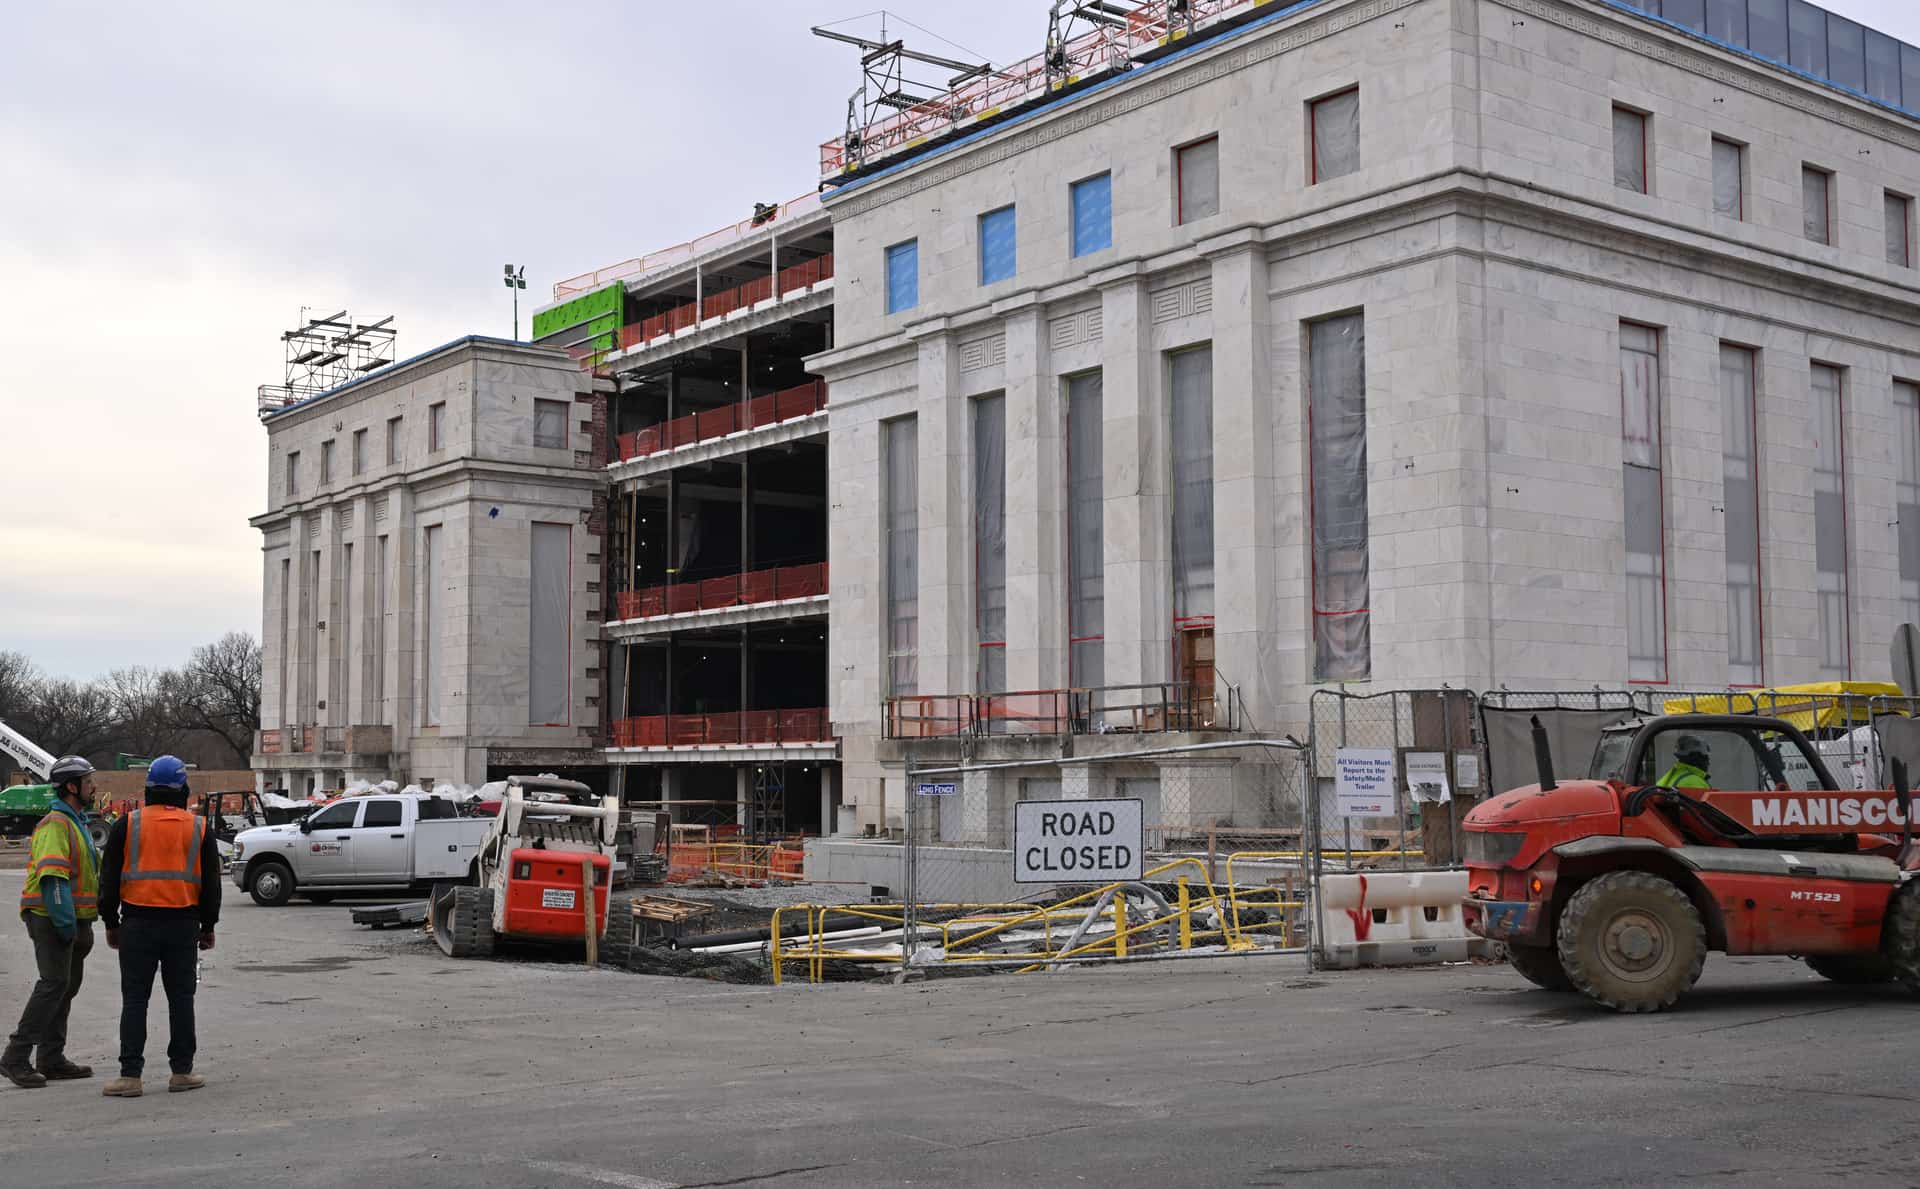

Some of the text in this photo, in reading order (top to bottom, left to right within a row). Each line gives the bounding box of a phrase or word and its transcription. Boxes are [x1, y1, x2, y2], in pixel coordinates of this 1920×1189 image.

[11, 743, 30, 758] ULTRA
[29, 754, 46, 770] BOOM
[1337, 758, 1347, 766] All
[1041, 811, 1115, 836] ROAD
[1025, 845, 1131, 871] CLOSED
[1791, 890, 1841, 902] MT523
